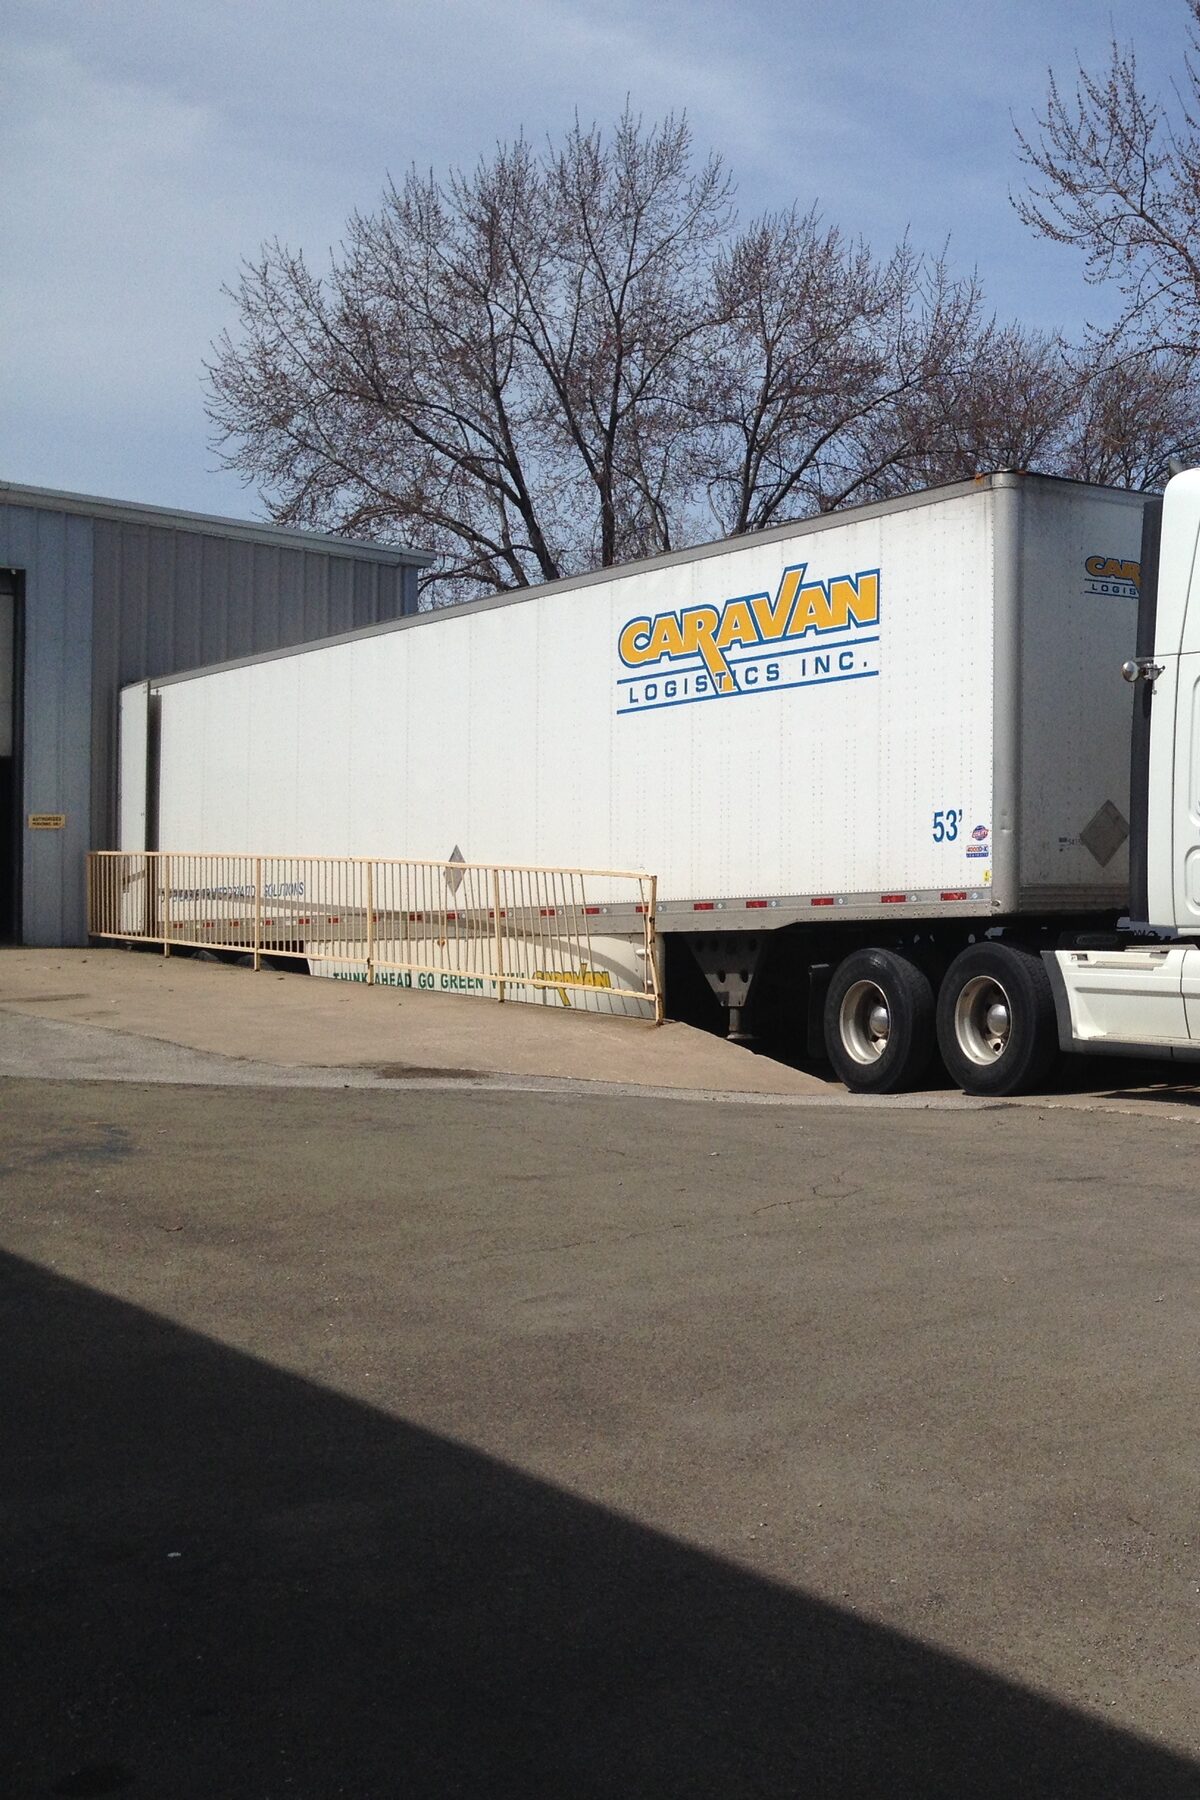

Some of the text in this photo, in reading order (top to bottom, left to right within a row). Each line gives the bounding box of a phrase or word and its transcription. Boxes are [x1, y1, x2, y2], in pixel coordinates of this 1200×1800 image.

[618, 563, 880, 692] CARAVAN
[629, 651, 868, 704] LOGISTICS INC.
[932, 809, 963, 842] 53'
[375, 972, 412, 988] AHEAD
[418, 972, 435, 988] GO
[441, 973, 483, 989] GREEN
